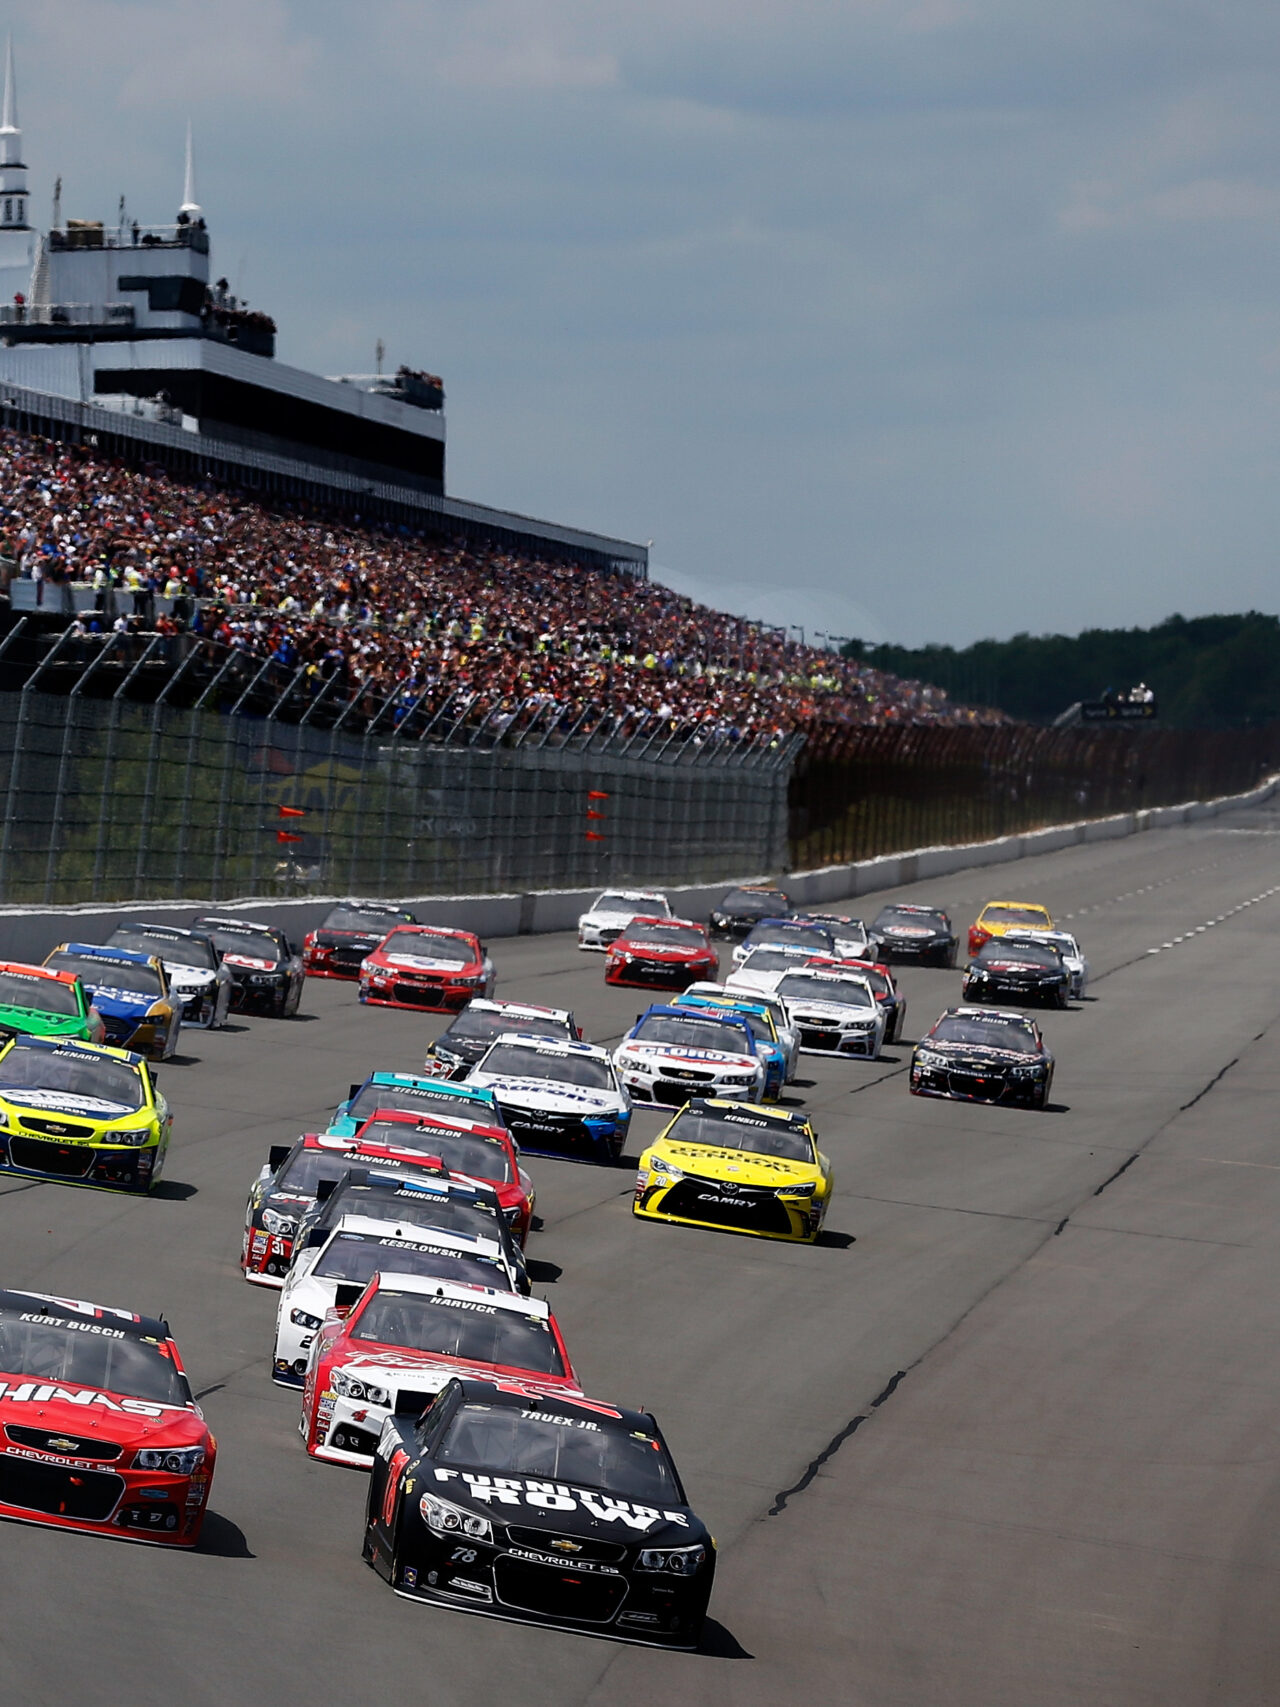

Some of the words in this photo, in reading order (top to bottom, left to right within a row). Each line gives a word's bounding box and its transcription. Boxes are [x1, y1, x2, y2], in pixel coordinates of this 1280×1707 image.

[1, 970, 40, 982] PATRICK
[52, 1049, 101, 1062] MENARD
[392, 1086, 456, 1102] STENHOUSE
[510, 1121, 566, 1134] CAMRY
[724, 1114, 768, 1127] KENSETH
[415, 1125, 463, 1138] LARSON
[343, 1151, 402, 1168] NEWMAN
[654, 1176, 667, 1186] 20
[394, 1188, 449, 1204] JOHNSON
[697, 1193, 756, 1208] CAMRY
[271, 1240, 284, 1256] 31
[379, 1237, 463, 1260] KESELOWSKI
[430, 1296, 497, 1316] HARVICK
[19, 1312, 66, 1328] KURT
[66, 1320, 126, 1339] BUSCH
[520, 1410, 575, 1428] TRUEX
[577, 1420, 602, 1433] JR.
[6, 1446, 92, 1470] CHEVROLET
[96, 1463, 116, 1473] SS
[433, 1467, 690, 1528] FURNITURE
[469, 1483, 658, 1532] ROW
[450, 1546, 478, 1563] 78
[508, 1547, 596, 1571] CHEVROLET
[600, 1565, 619, 1575] SS
